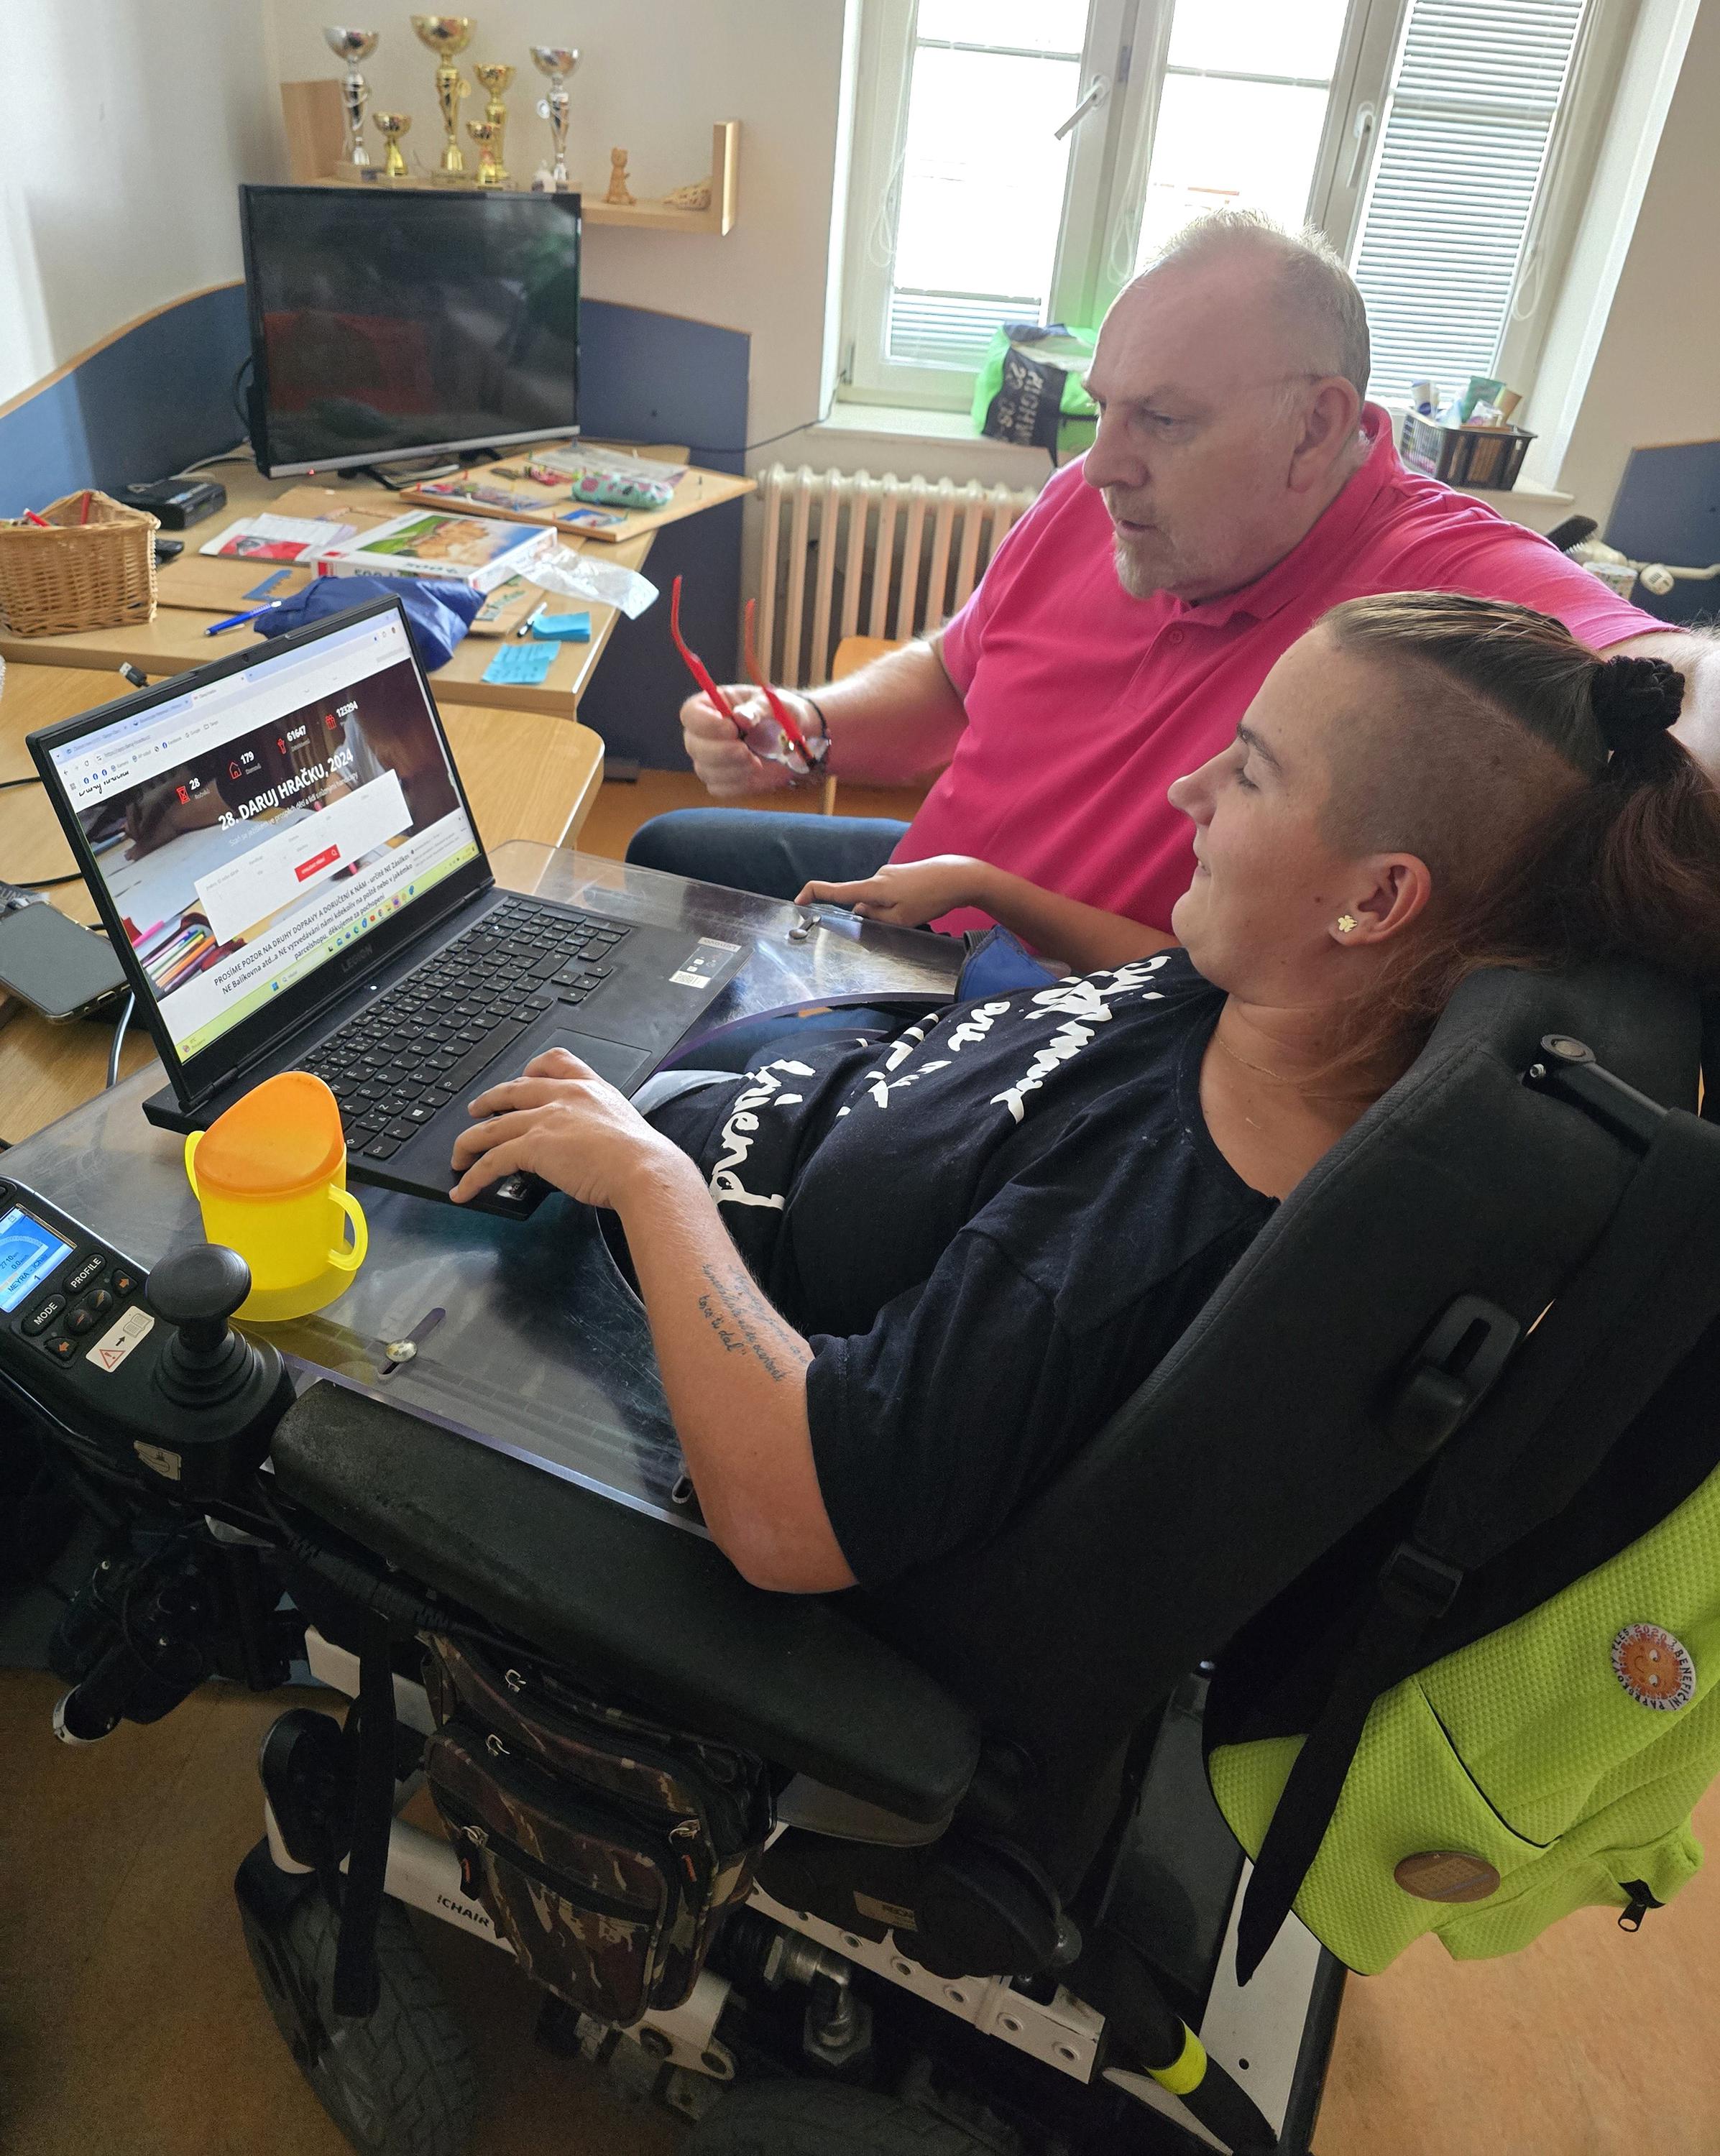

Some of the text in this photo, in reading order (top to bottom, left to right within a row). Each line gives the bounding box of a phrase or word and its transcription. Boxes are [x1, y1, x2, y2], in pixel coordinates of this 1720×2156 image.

[336, 700, 358, 718] 123294
[287, 724, 306, 742] 61647
[240, 750, 254, 765] 179
[188, 778, 201, 791] 28
[217, 747, 354, 831] 28. DARUJ HRAČKU, 2024
[213, 963, 242, 985] PROSÍME
[241, 949, 263, 967] POZOR
[262, 943, 272, 954] NA
[272, 929, 292, 947] DRUHY
[292, 913, 318, 934] DOPRAVY
[322, 891, 350, 913] DORUČENÍ
[354, 880, 367, 893] NÁM
[369, 869, 384, 883] určitě
[383, 864, 392, 873] NE
[221, 983, 232, 994] NE
[231, 964, 262, 988] Balíkovna
[277, 946, 287, 957] NE
[287, 925, 320, 950] vyzvedávání
[333, 901, 355, 918] kdekoliv
[362, 885, 377, 901] poště
[376, 879, 389, 890] nebo
[294, 934, 328, 960] parcelshopu,
[328, 916, 353, 936] děkujeme
[359, 895, 385, 915] pochopení
[703, 938, 737, 951] Lenovo
[341, 944, 373, 972] LEGION
[8, 1272, 29, 1292] MEYRA
[70, 1258, 101, 1288] PROFILE
[33, 1302, 58, 1325] MODE
[1611, 1628, 1629, 1651] PLES
[1611, 1658, 1665, 1710] PAPRSKOVÝ
[1670, 1649, 1693, 1710] BENEFIČNÍ
